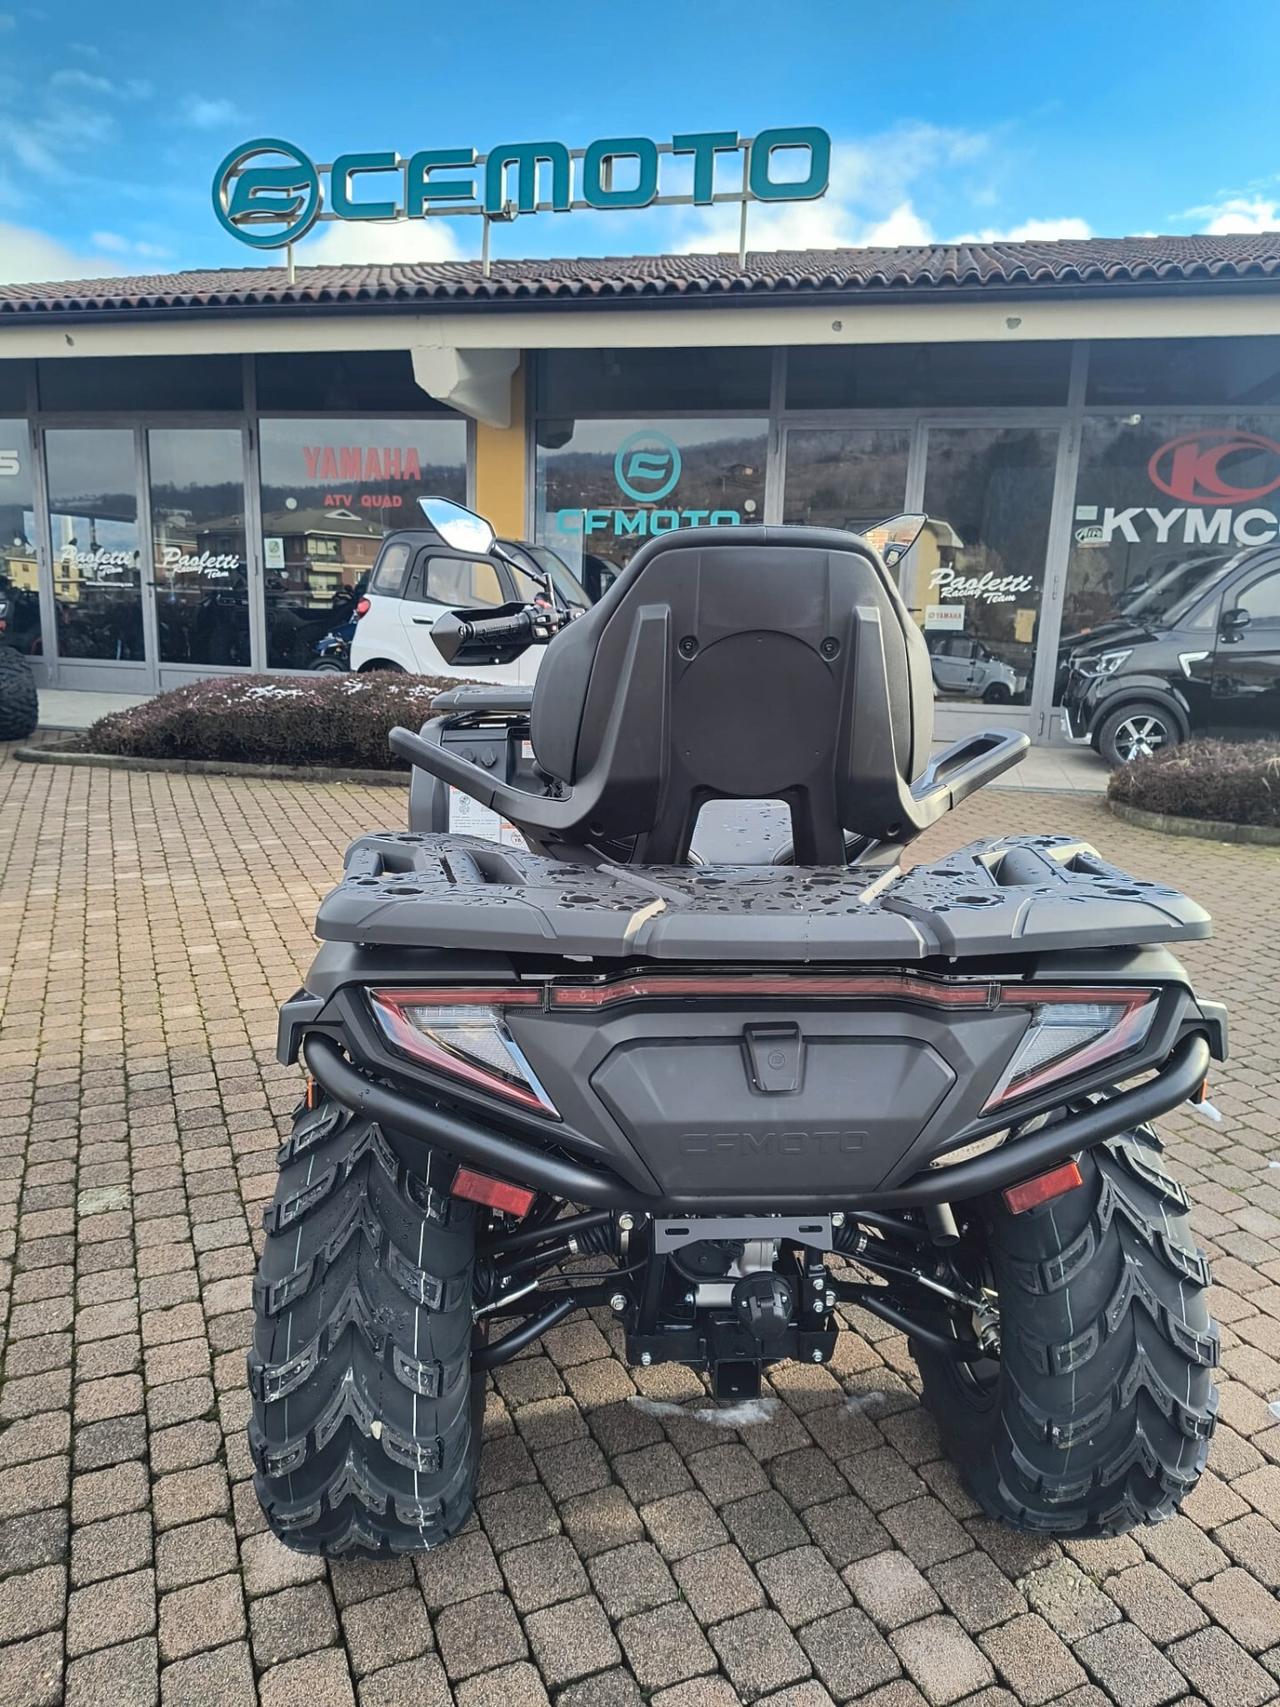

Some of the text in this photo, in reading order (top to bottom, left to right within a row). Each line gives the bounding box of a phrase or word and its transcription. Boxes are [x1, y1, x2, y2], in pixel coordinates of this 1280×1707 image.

[331, 126, 831, 220] CFMOTO
[302, 446, 421, 481] YAMAHA
[323, 495, 403, 509] ATV QUAD
[555, 508, 741, 536] CFMOTO
[1102, 506, 1280, 547] KYMC
[60, 544, 132, 566] Paoletti
[162, 546, 240, 569] Paoletti
[172, 564, 230, 579] Racing Team
[928, 567, 1034, 593] Paoletti
[940, 586, 1017, 604] Racing Team
[680, 1130, 869, 1156] CFMOTO
